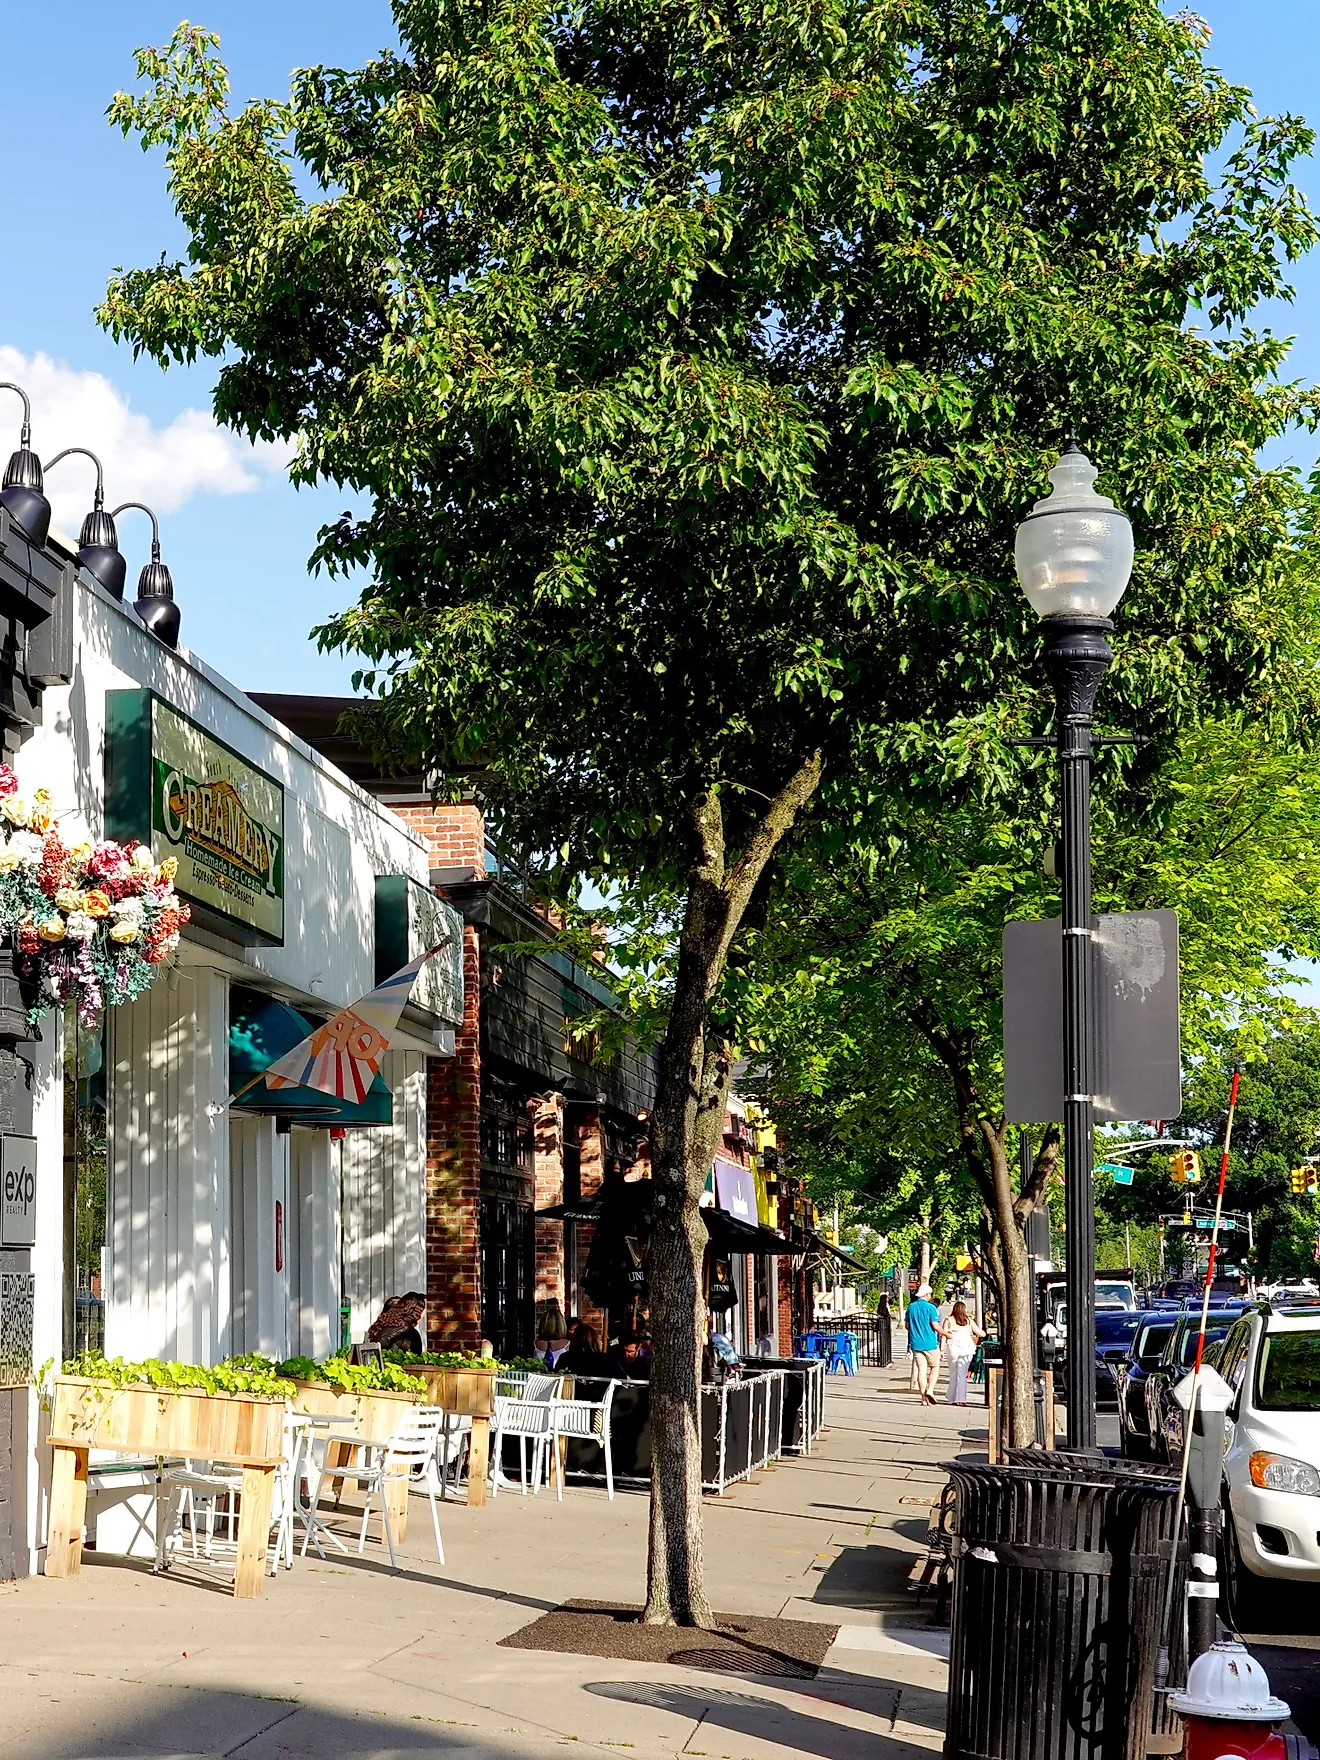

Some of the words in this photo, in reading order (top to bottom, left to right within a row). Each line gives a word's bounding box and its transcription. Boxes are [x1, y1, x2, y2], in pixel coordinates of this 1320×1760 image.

[162, 768, 279, 896] CREAMERY
[186, 840, 228, 874] Homemade
[228, 862, 240, 881] Ice
[240, 870, 261, 894] Cream
